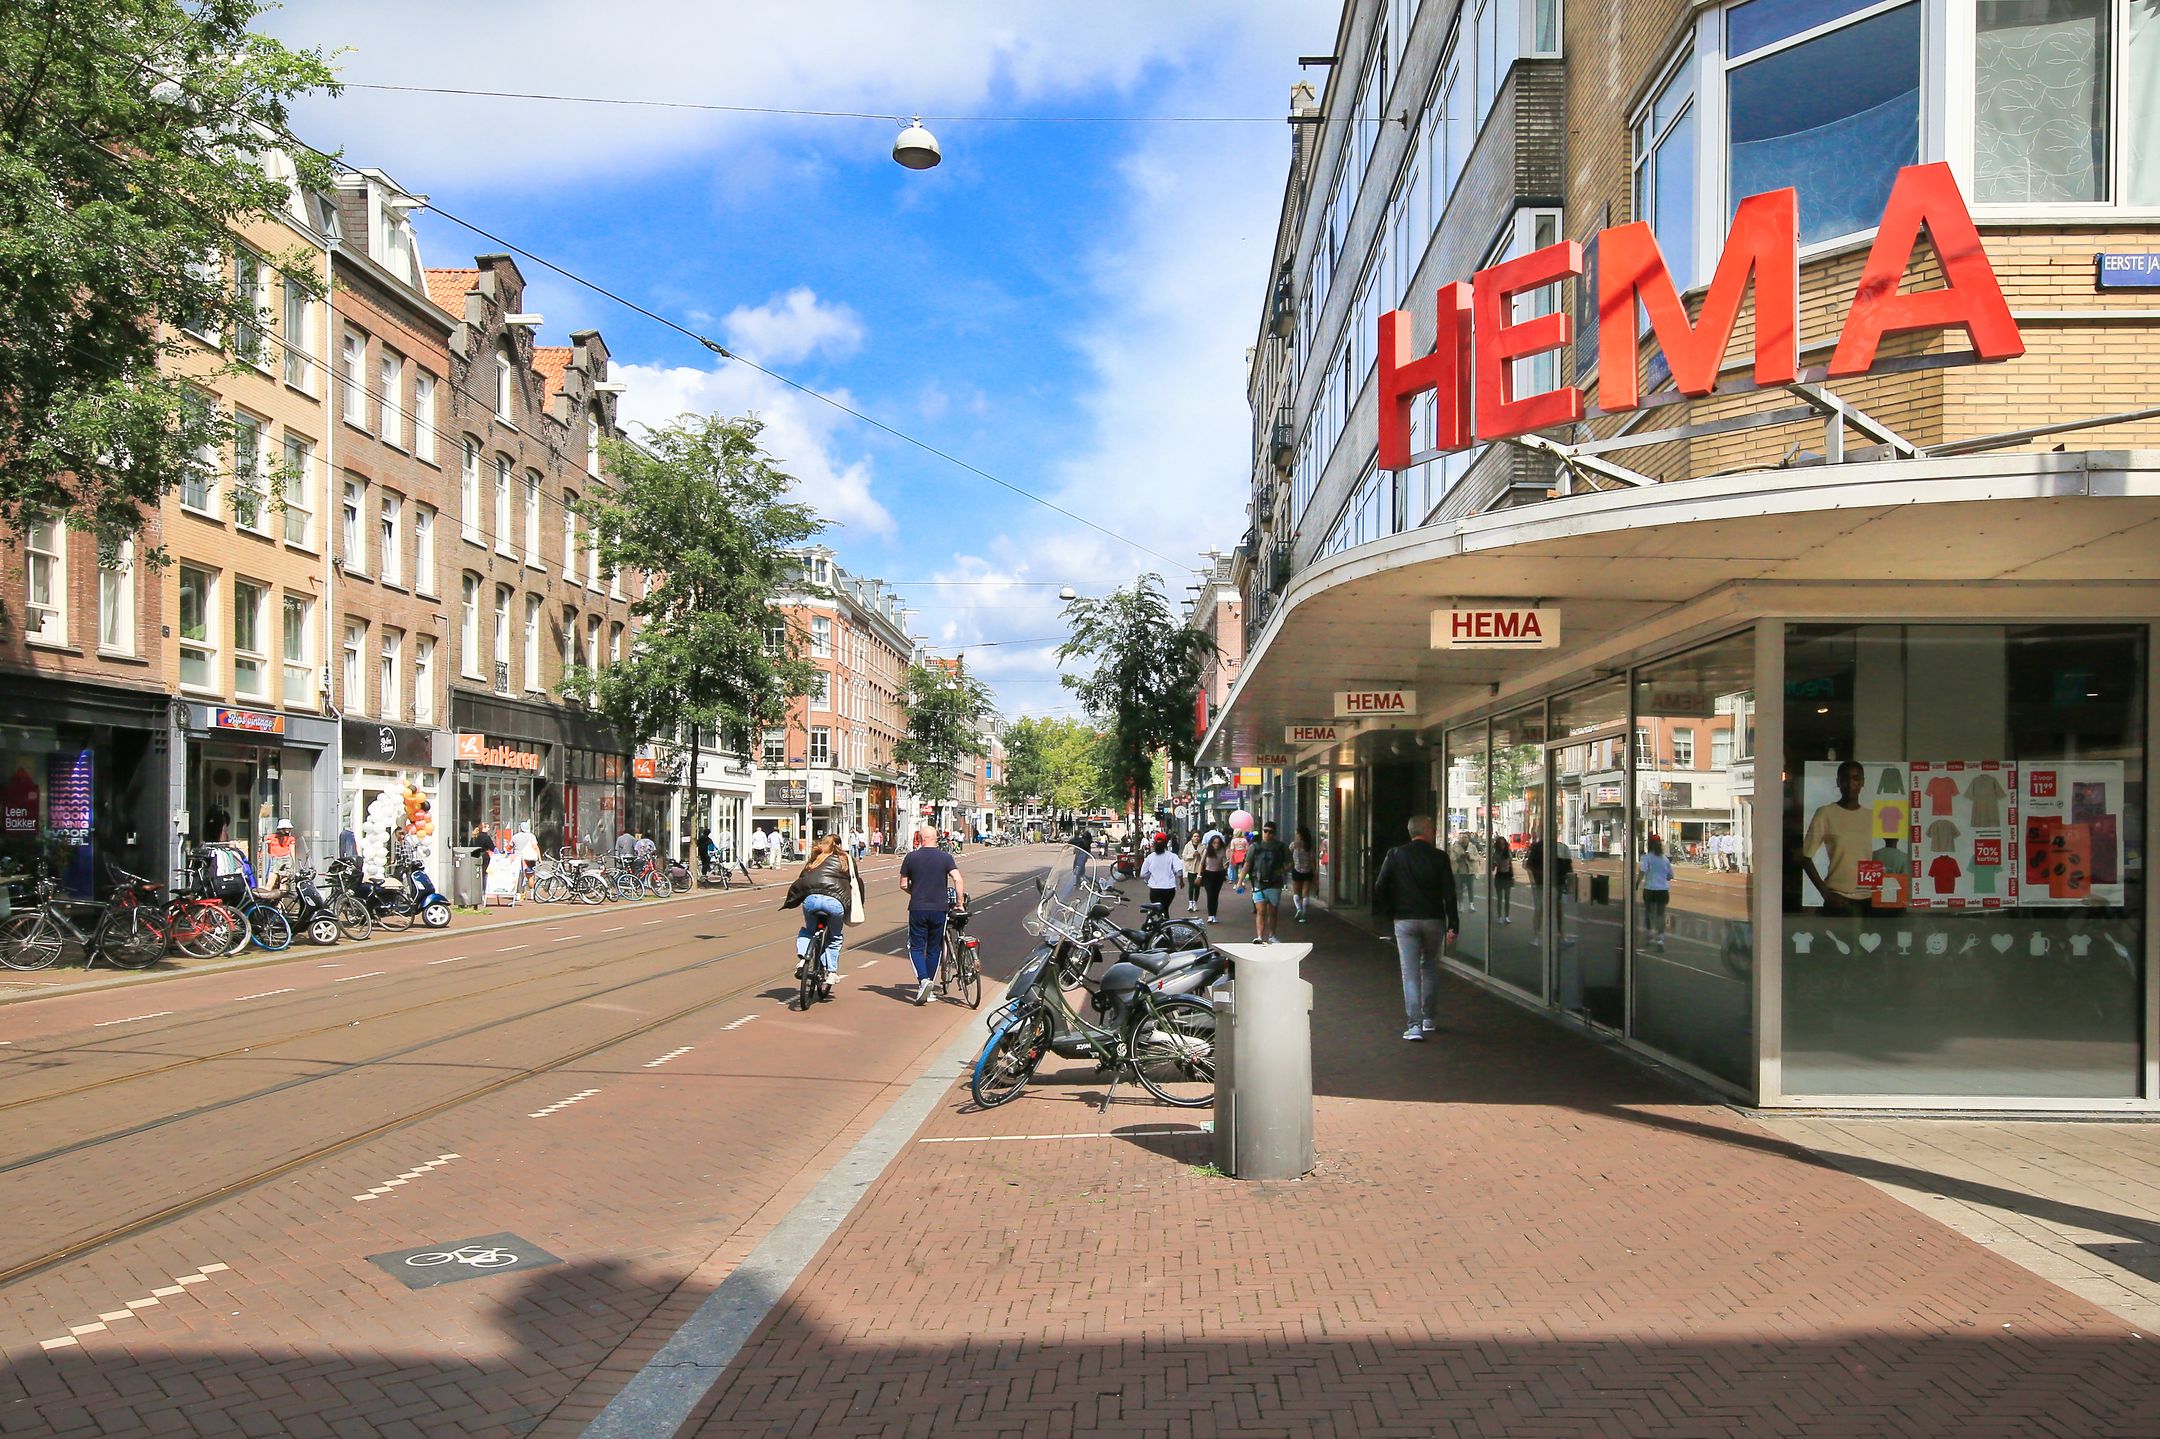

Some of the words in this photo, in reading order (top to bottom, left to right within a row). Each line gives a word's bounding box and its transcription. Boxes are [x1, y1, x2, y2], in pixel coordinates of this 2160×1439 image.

[2104, 255, 2144, 270] EERSTE
[1378, 161, 2025, 471] HEMA
[1452, 612, 1542, 637] HEMA
[1346, 692, 1405, 710] HEMA
[1293, 727, 1336, 740] HEMA
[476, 745, 539, 770] anHaren
[1256, 754, 1288, 765] HEMA
[5, 807, 27, 816] Leen
[51, 812, 89, 820] WOON
[5, 818, 36, 828] Bakker
[51, 821, 89, 829] ZINNIG
[1977, 847, 1998, 856] 70%
